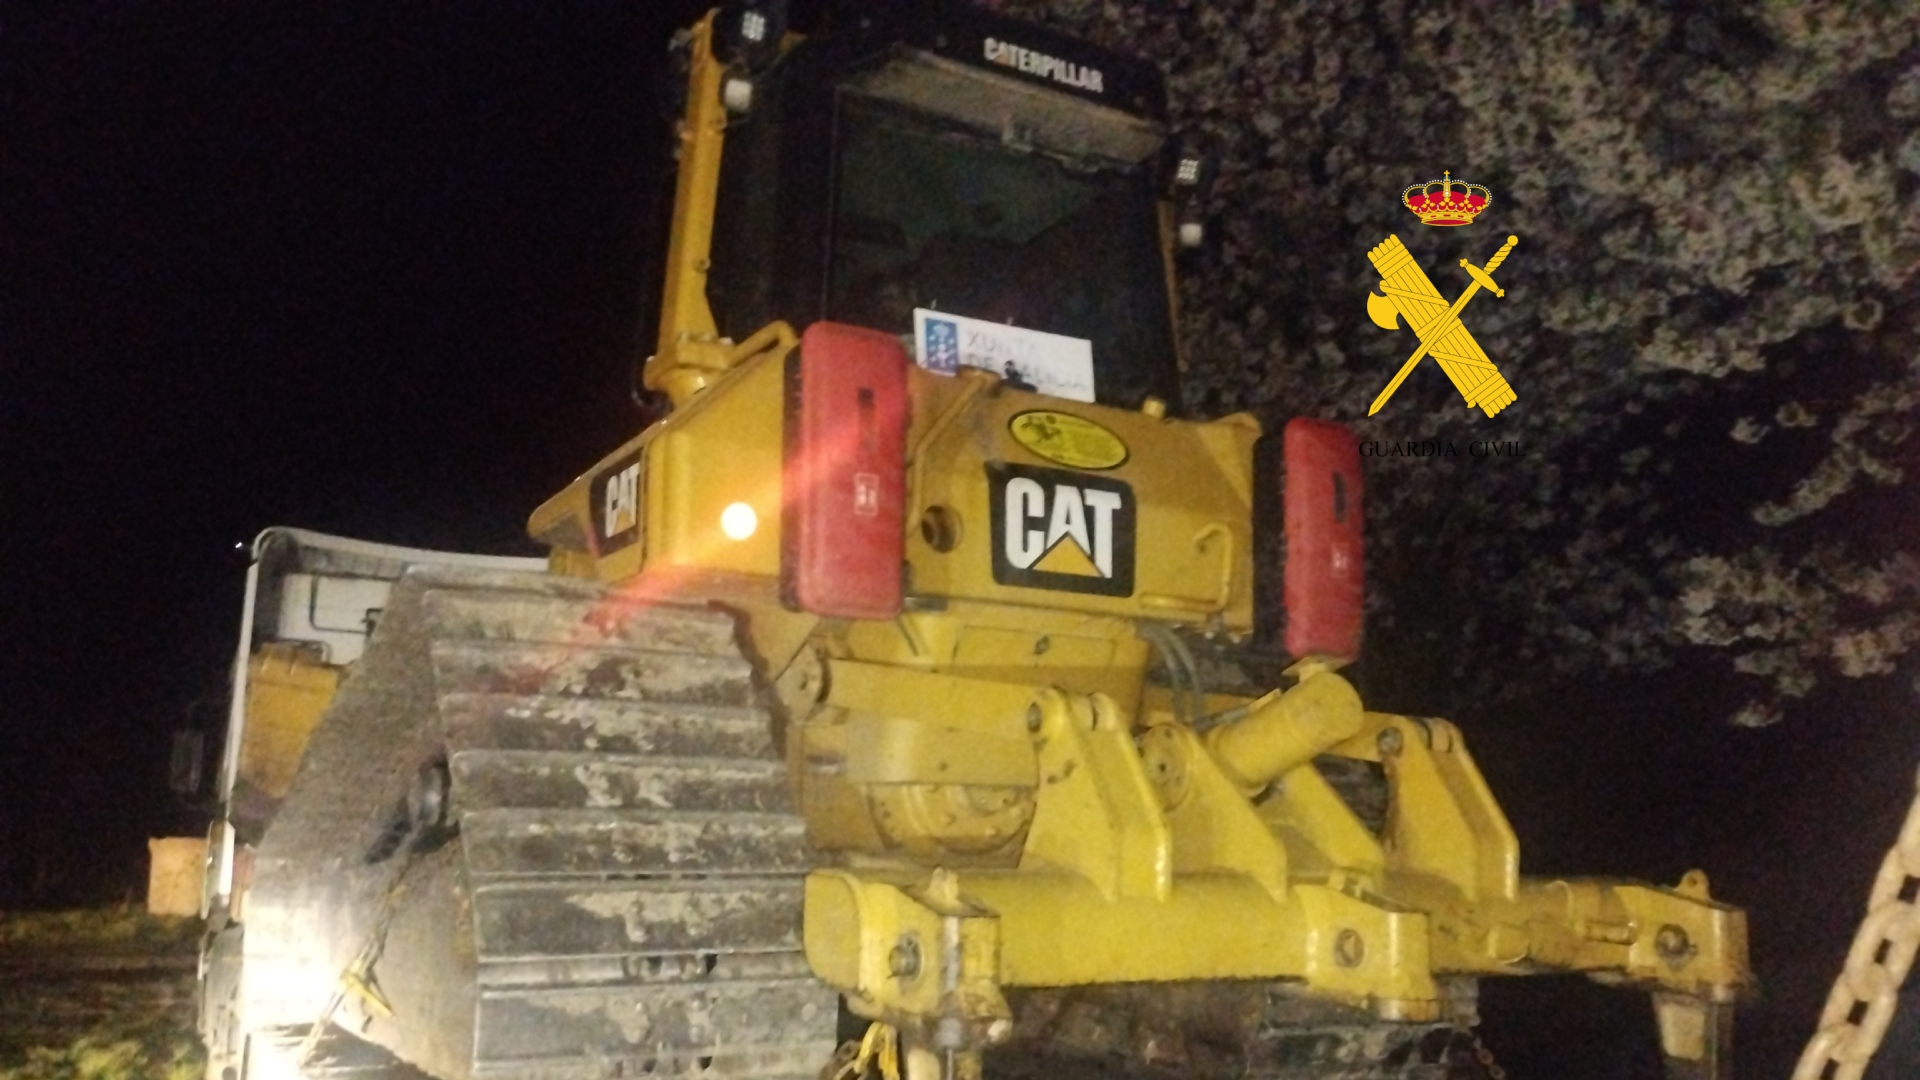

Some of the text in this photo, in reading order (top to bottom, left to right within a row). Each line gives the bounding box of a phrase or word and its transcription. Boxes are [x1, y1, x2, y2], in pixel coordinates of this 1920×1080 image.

[984, 37, 1103, 93] CATERPILLAR
[1004, 360, 1088, 392] ALICIA
[605, 461, 640, 538] CAT
[1005, 477, 1122, 579] CAT
